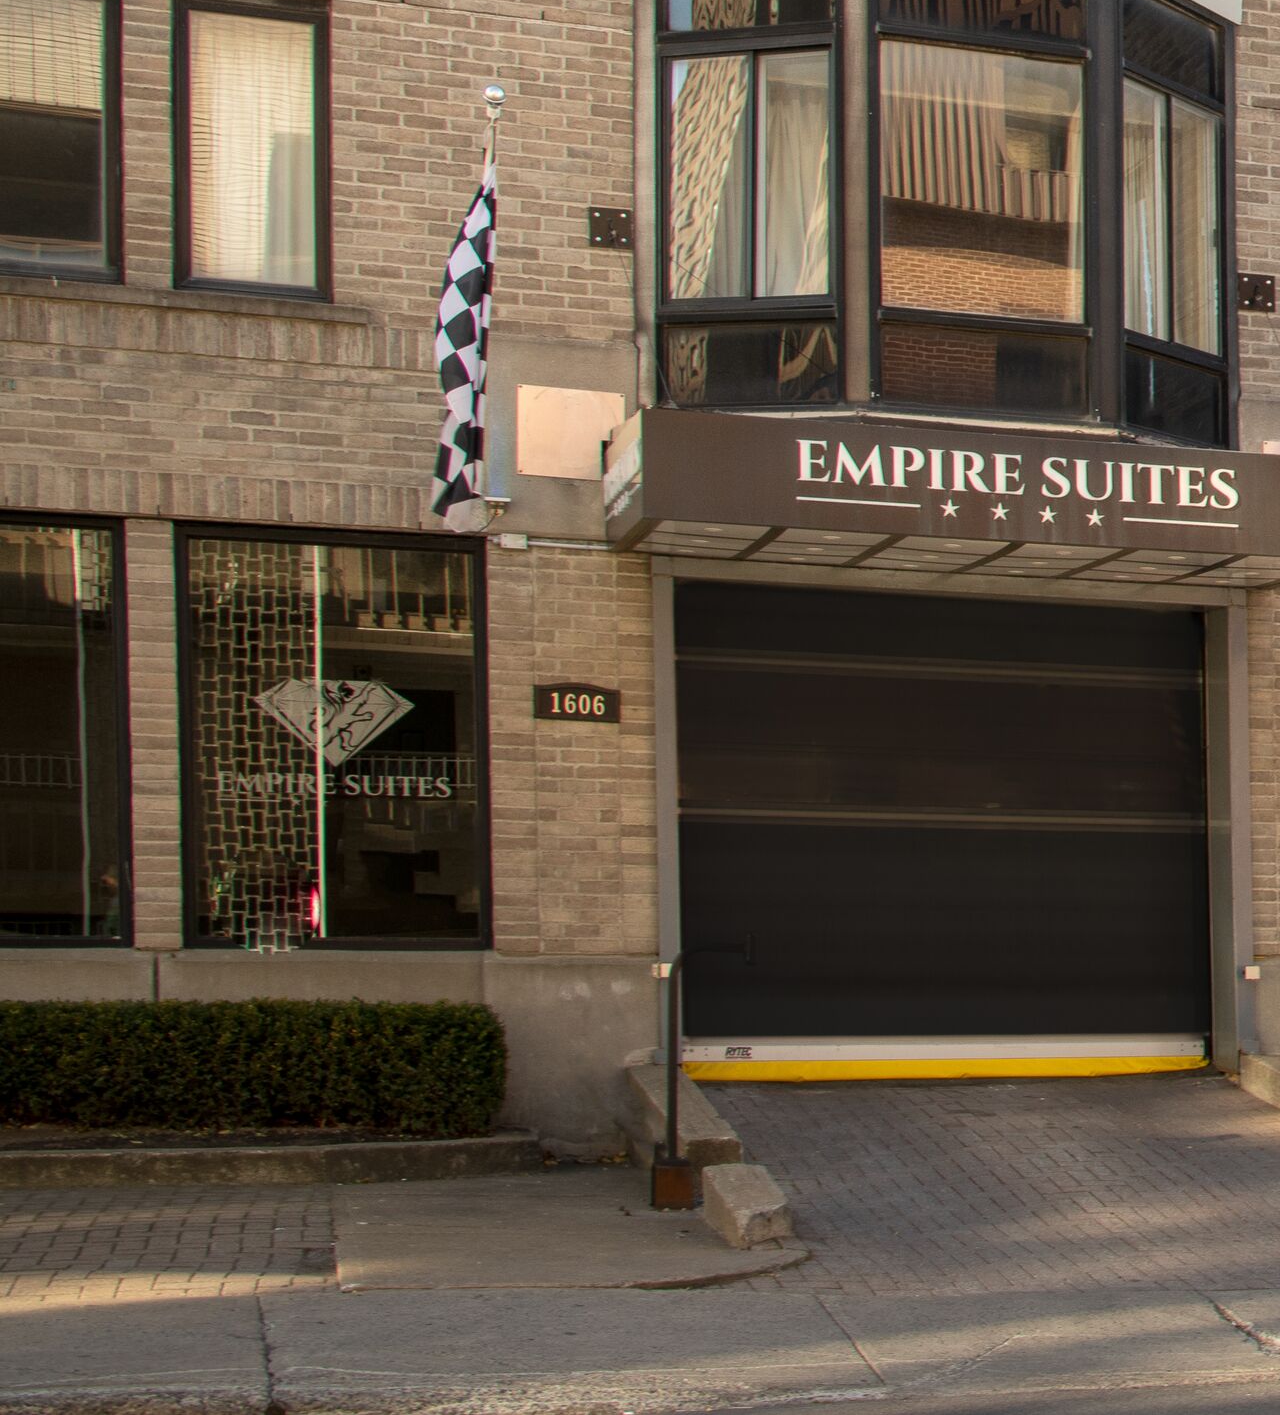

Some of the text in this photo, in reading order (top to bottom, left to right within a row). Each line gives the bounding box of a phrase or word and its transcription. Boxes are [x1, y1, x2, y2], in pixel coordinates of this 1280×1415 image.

[796, 439, 1240, 510] EMPIRE SUITES
[551, 691, 606, 716] 1606
[216, 770, 453, 798] EMPIRE SUITES
